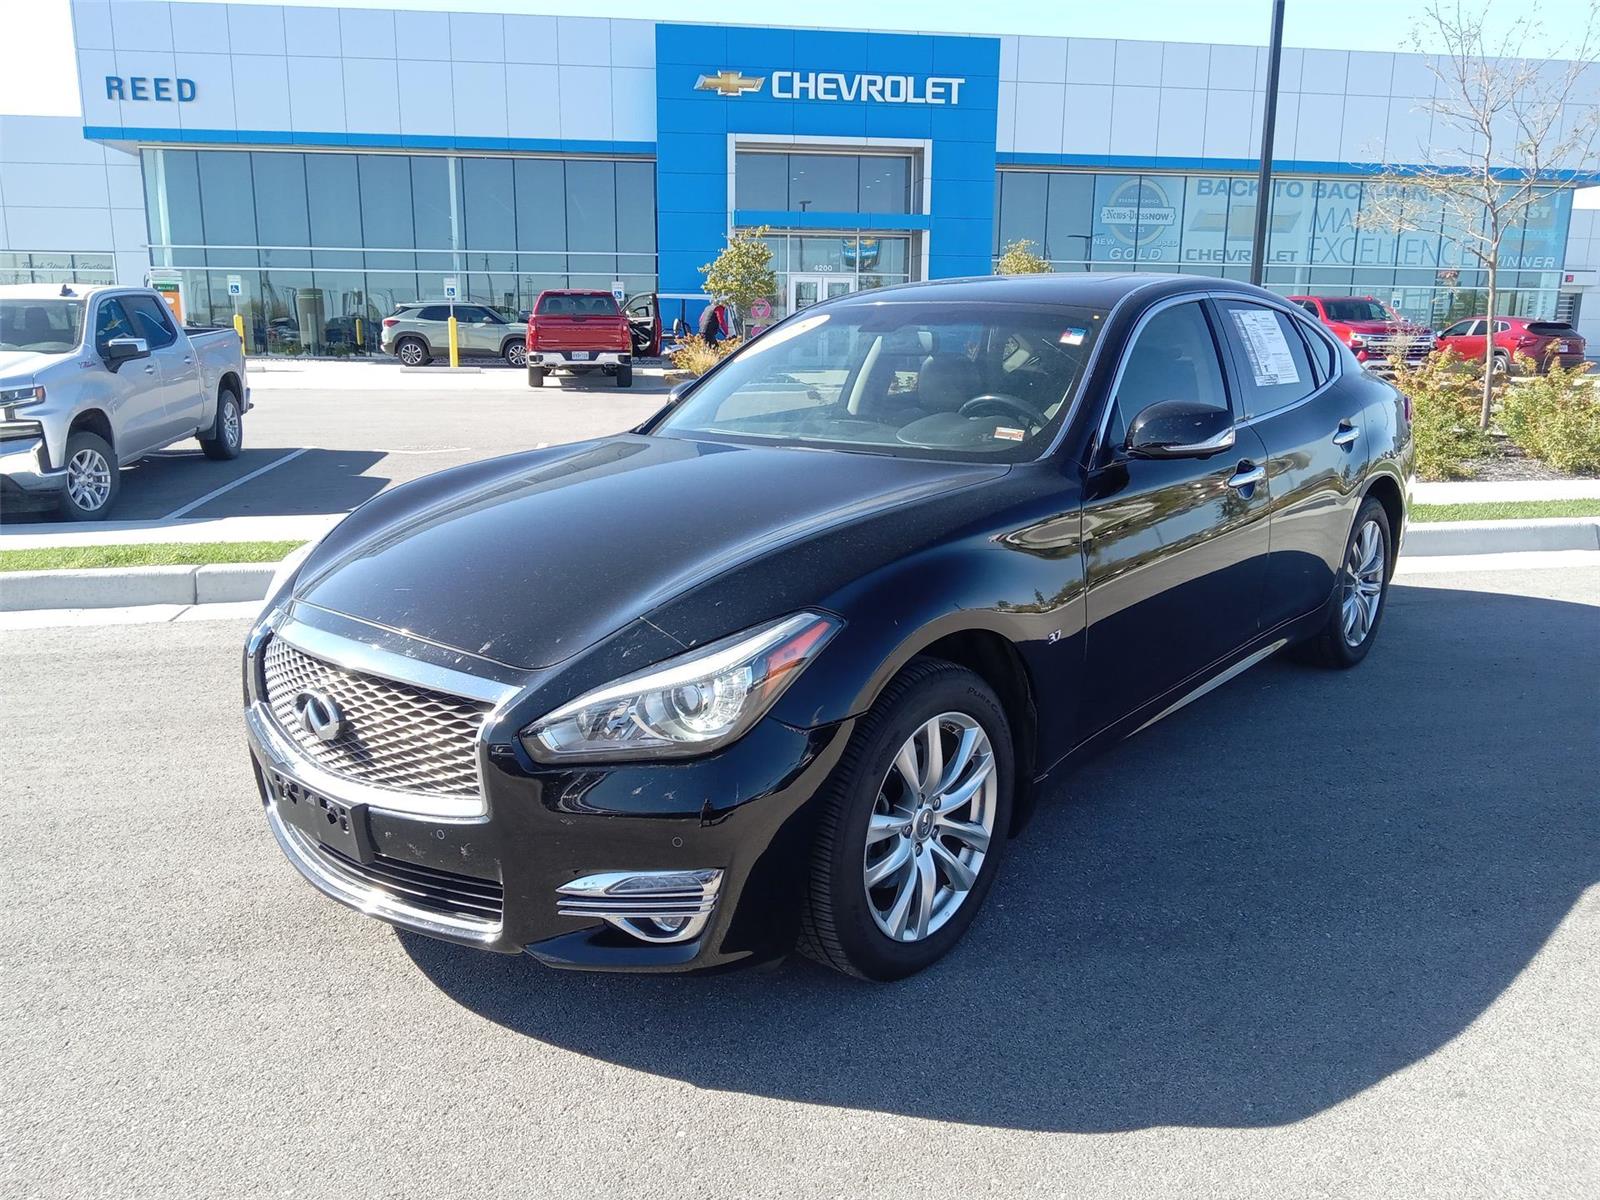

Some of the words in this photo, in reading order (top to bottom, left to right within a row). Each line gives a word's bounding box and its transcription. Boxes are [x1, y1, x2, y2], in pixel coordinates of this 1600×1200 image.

[105, 76, 196, 102] REED
[771, 71, 965, 104] CHEVROLET
[1109, 247, 1162, 260] GOLD
[1185, 247, 1299, 263] CHEVRLET
[814, 264, 833, 272] 4200
